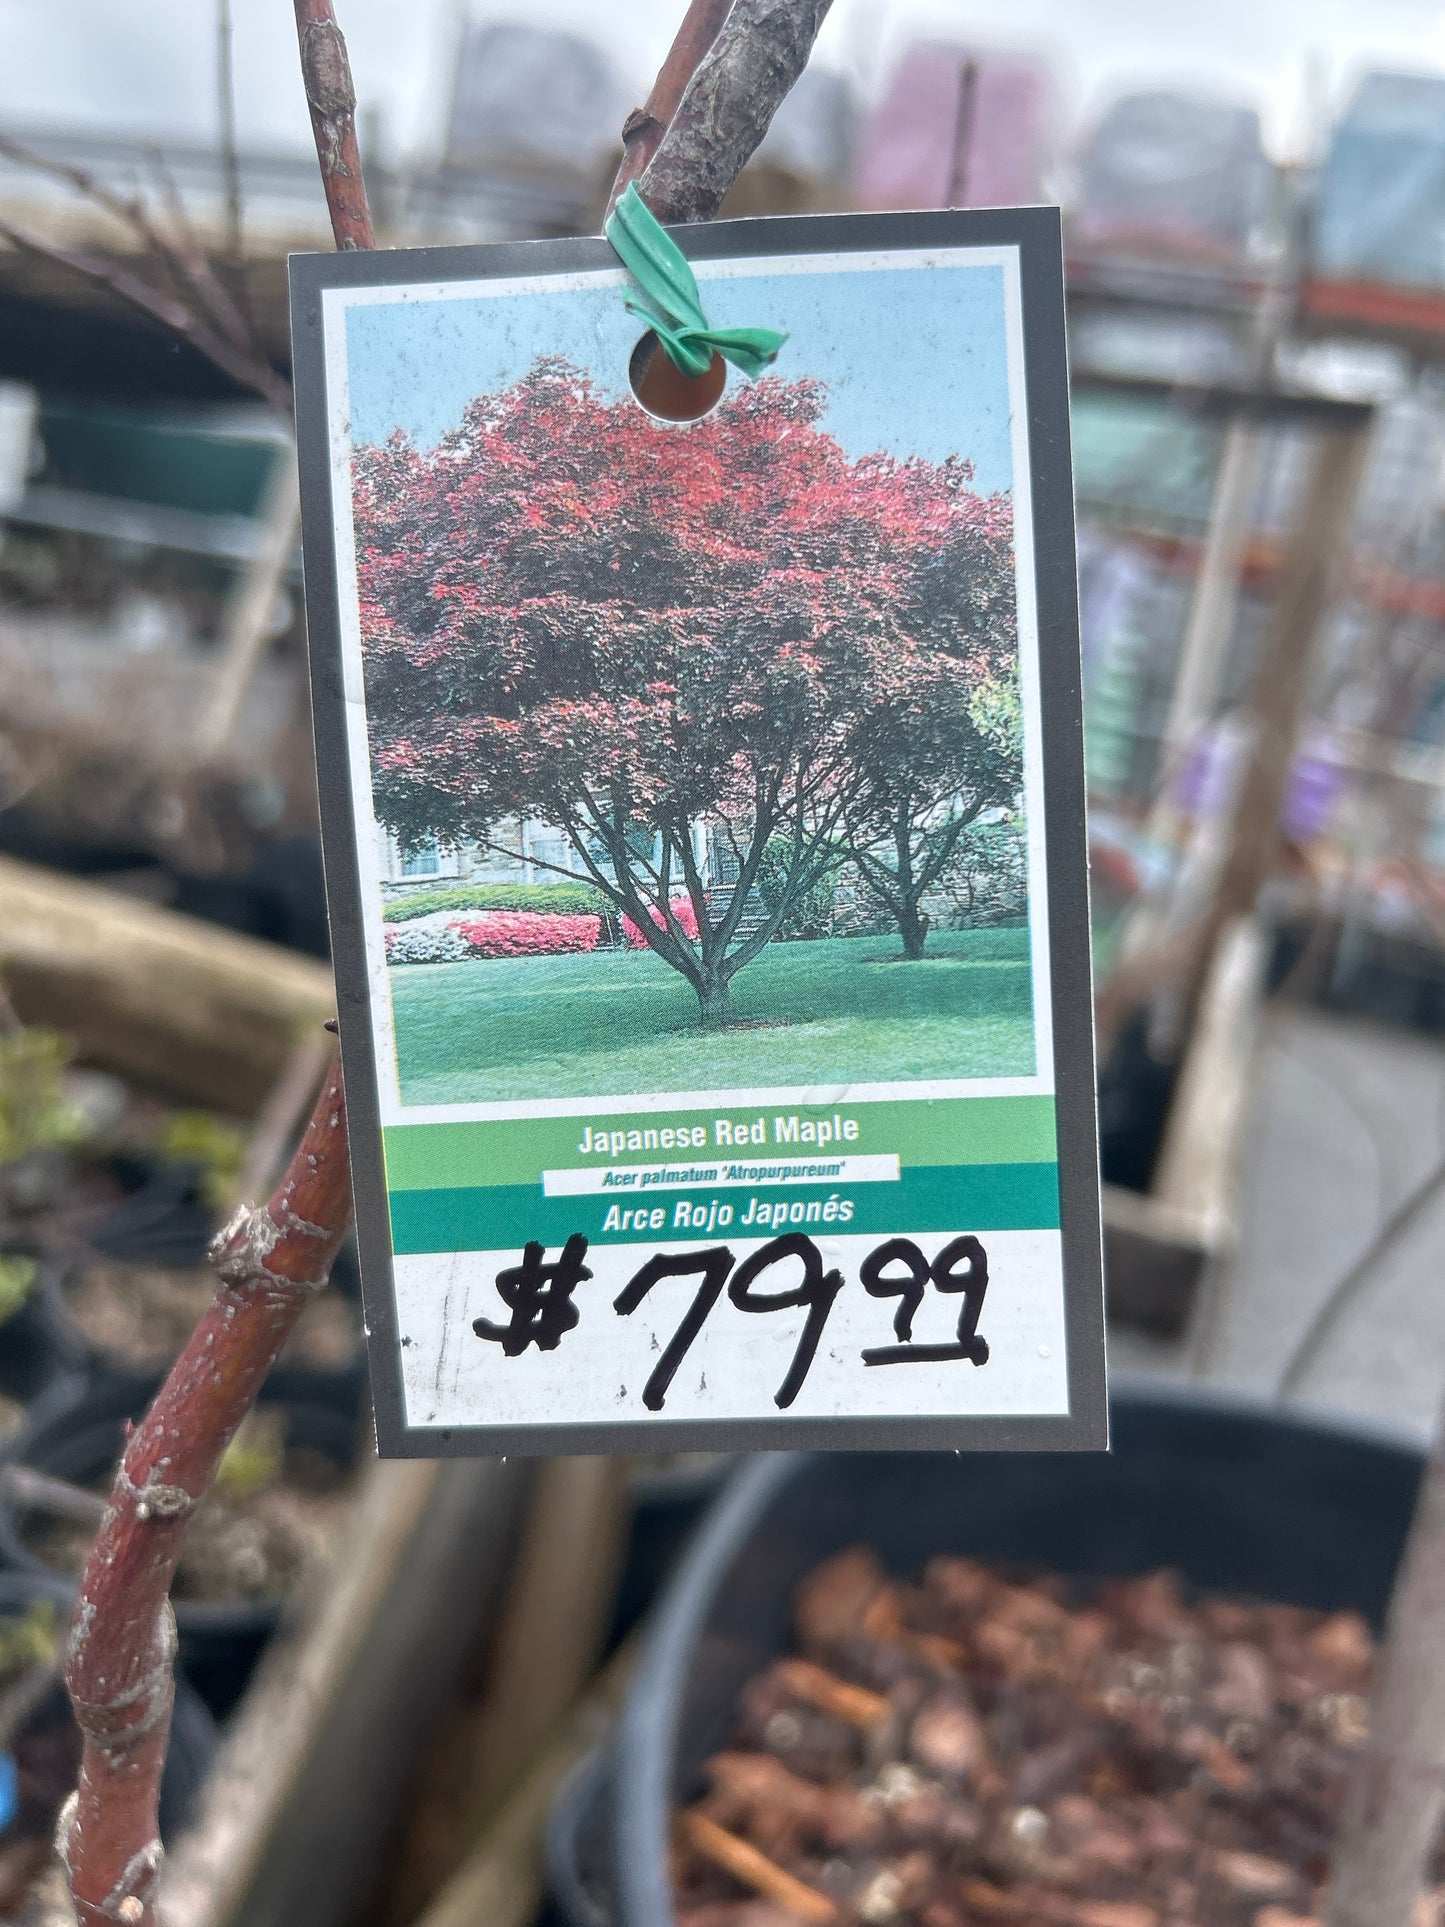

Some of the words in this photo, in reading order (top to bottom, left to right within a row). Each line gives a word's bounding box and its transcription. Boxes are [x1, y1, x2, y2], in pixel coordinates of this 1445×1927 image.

[579, 1126, 707, 1157] Japanese
[715, 1118, 766, 1146] Red
[775, 1114, 860, 1147] Maple
[601, 1171, 637, 1187] Acer
[639, 1167, 718, 1188] palmatum
[603, 1205, 666, 1231] Arce
[673, 1200, 734, 1233] Rojo
[741, 1194, 854, 1229] Japonés
